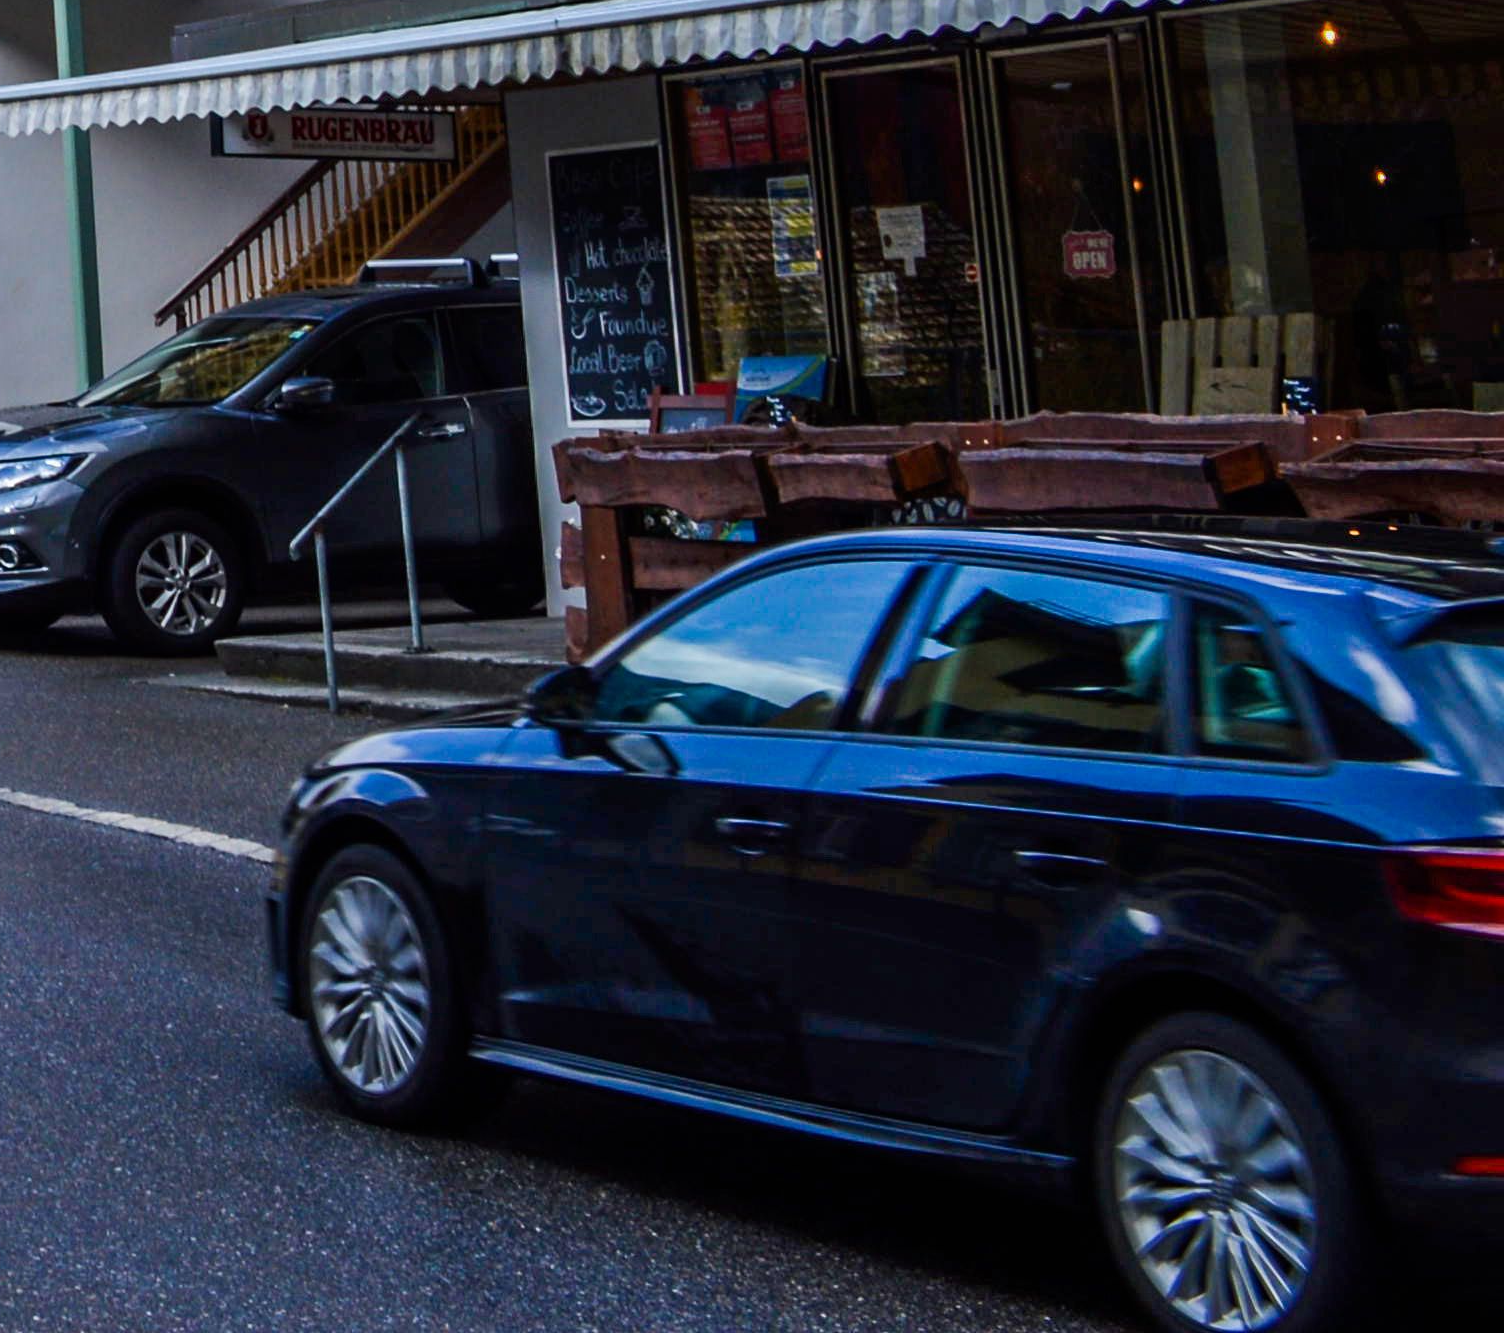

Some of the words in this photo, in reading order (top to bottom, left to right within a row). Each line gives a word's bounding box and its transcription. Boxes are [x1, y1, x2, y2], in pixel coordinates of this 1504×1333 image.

[584, 239, 608, 269] Hot
[1072, 251, 1106, 270] OPEN
[564, 276, 629, 304] Desserts
[614, 378, 651, 412] Sala
